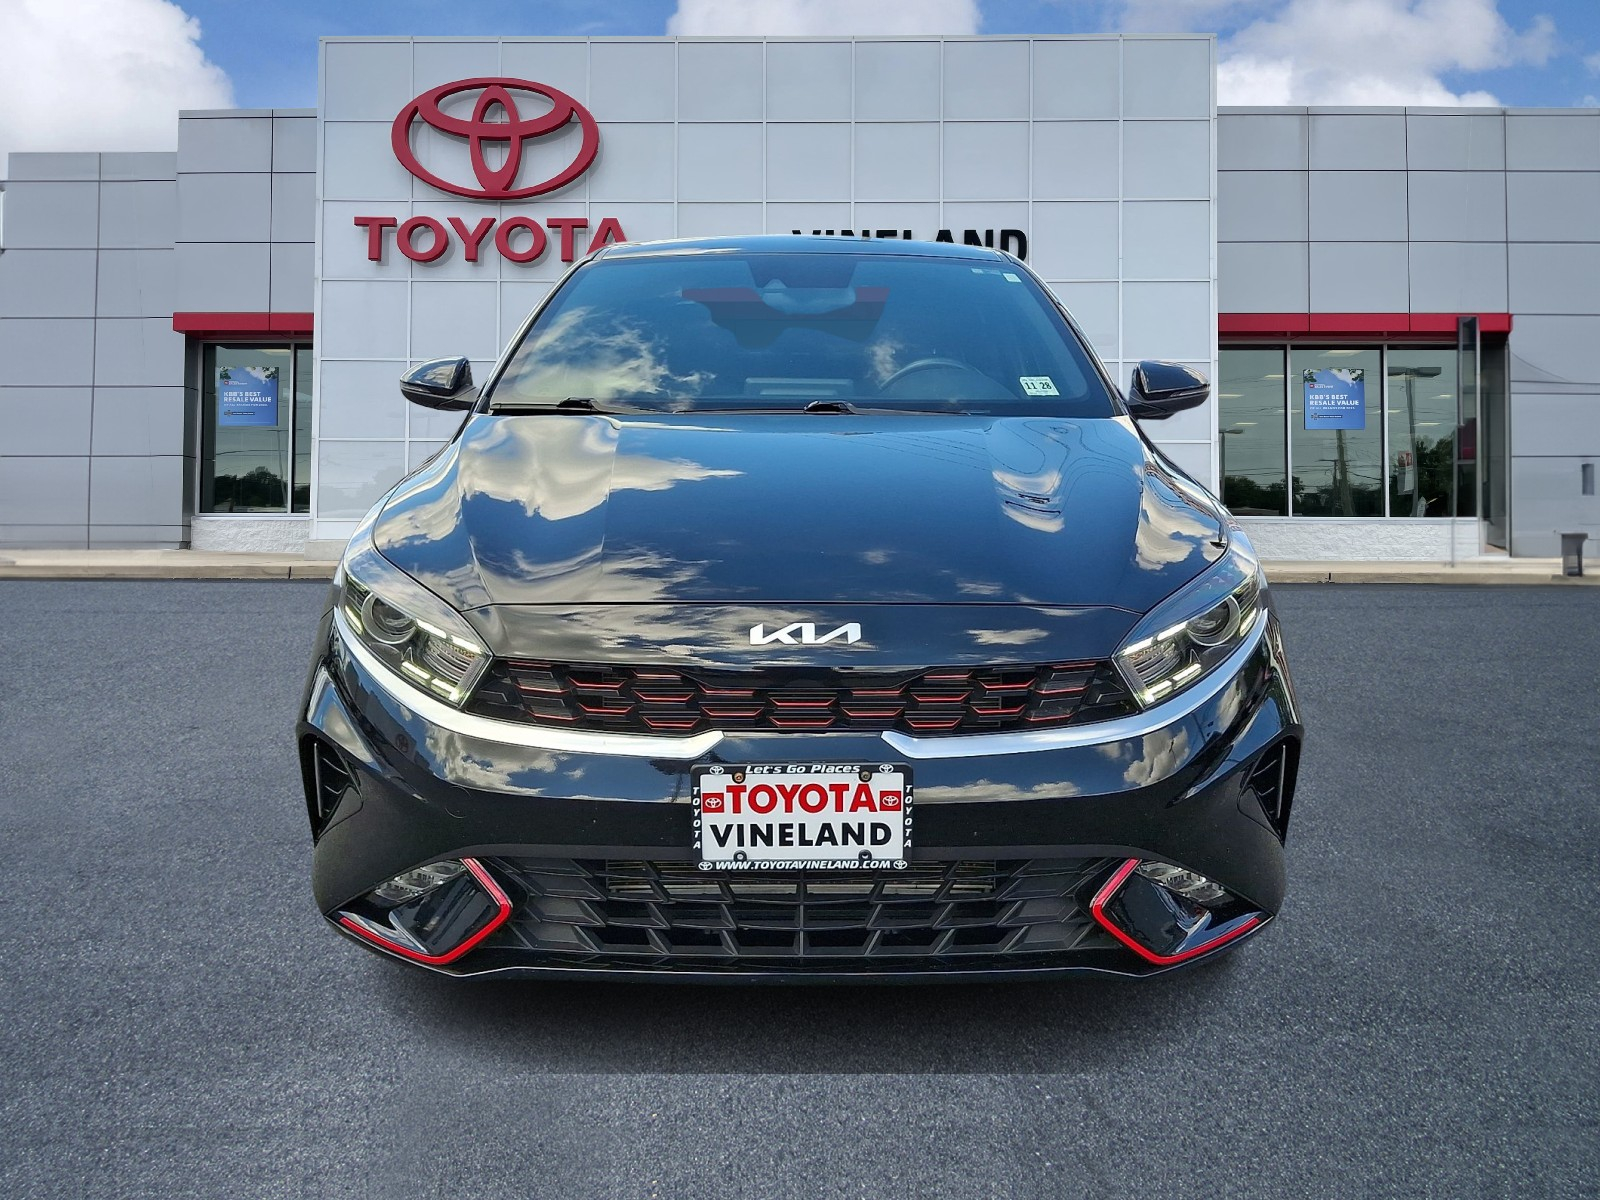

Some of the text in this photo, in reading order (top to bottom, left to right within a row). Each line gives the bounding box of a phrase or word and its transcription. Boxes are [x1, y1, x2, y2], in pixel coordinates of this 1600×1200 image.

[354, 216, 628, 263] TOYOTA
[749, 622, 861, 645] KIA
[745, 764, 861, 774] Let's Go Places
[725, 783, 878, 815] TOYOTA
[692, 786, 701, 849] TOYOTA
[903, 785, 913, 848] TOYOTA
[709, 822, 892, 848] VINELAND
[715, 860, 891, 870] WWW.TOYOTAVINELAND.COM
